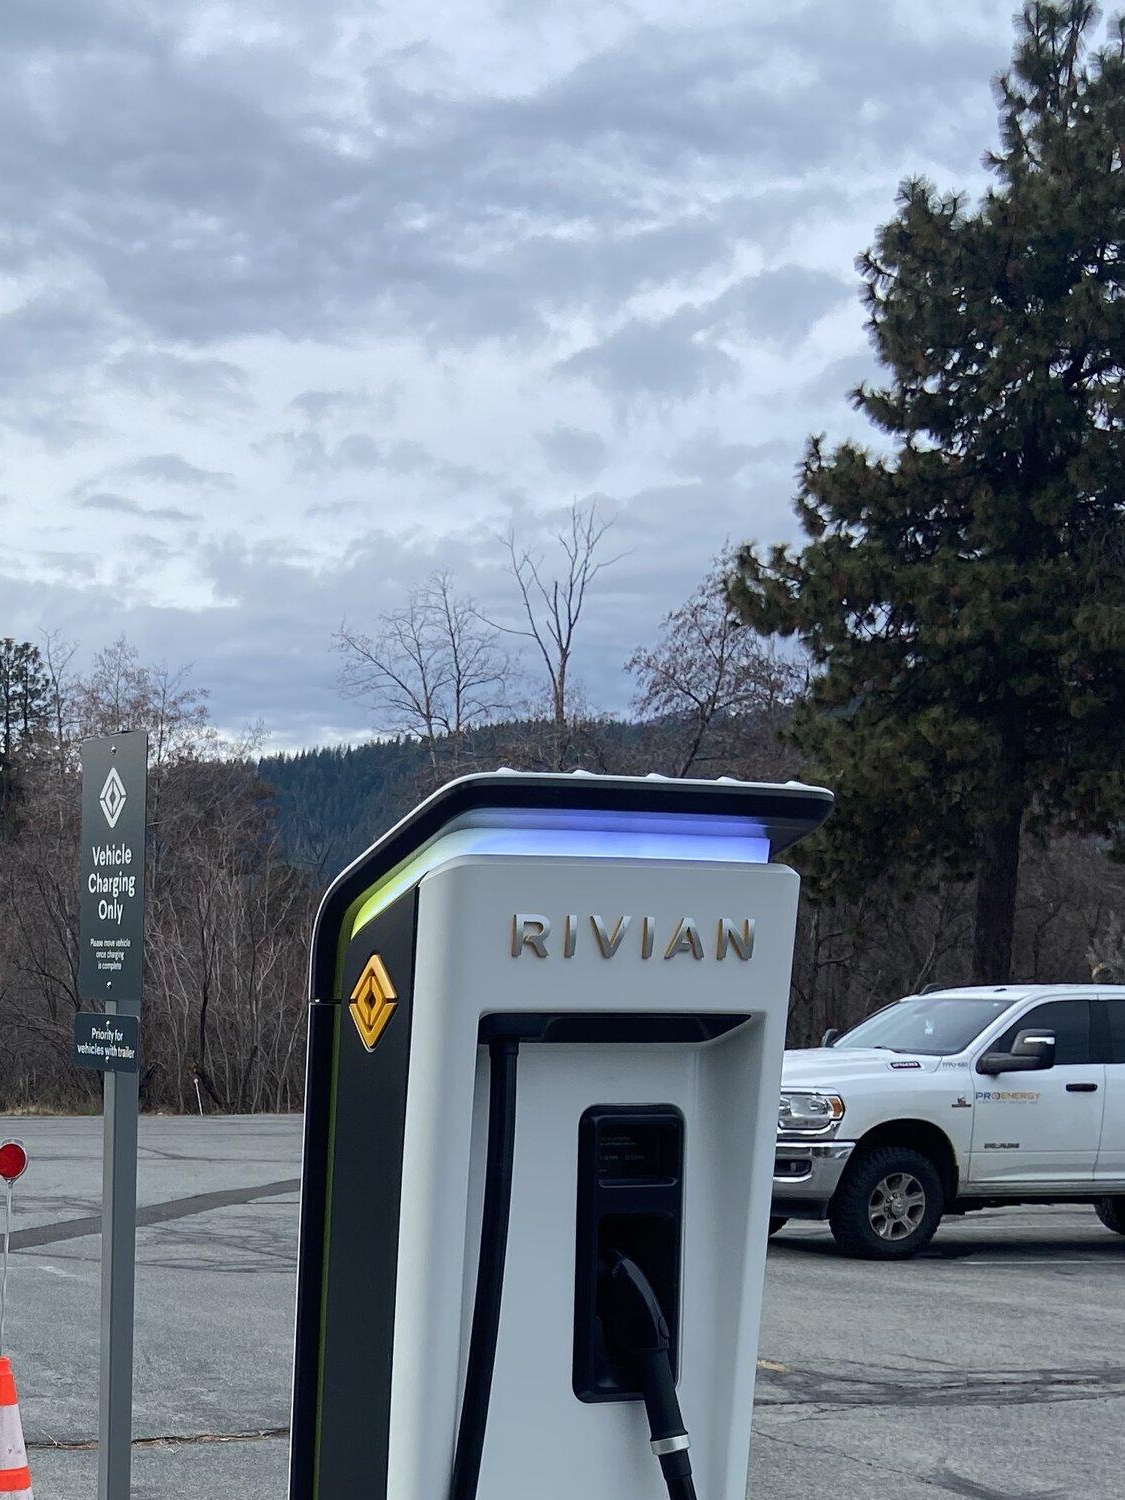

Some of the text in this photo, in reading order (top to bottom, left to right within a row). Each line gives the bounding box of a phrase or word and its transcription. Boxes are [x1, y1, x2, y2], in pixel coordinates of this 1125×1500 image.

[92, 843, 133, 867] Vehicle
[88, 871, 136, 898] Charging
[98, 899, 124, 925] Only
[90, 938, 131, 948] Please move vehicle
[510, 913, 756, 961] RIVIAN
[95, 950, 125, 960] once charging
[102, 962, 123, 971] complete
[91, 1027, 124, 1044] Priority for
[77, 1041, 135, 1059] vehicles with trailer
